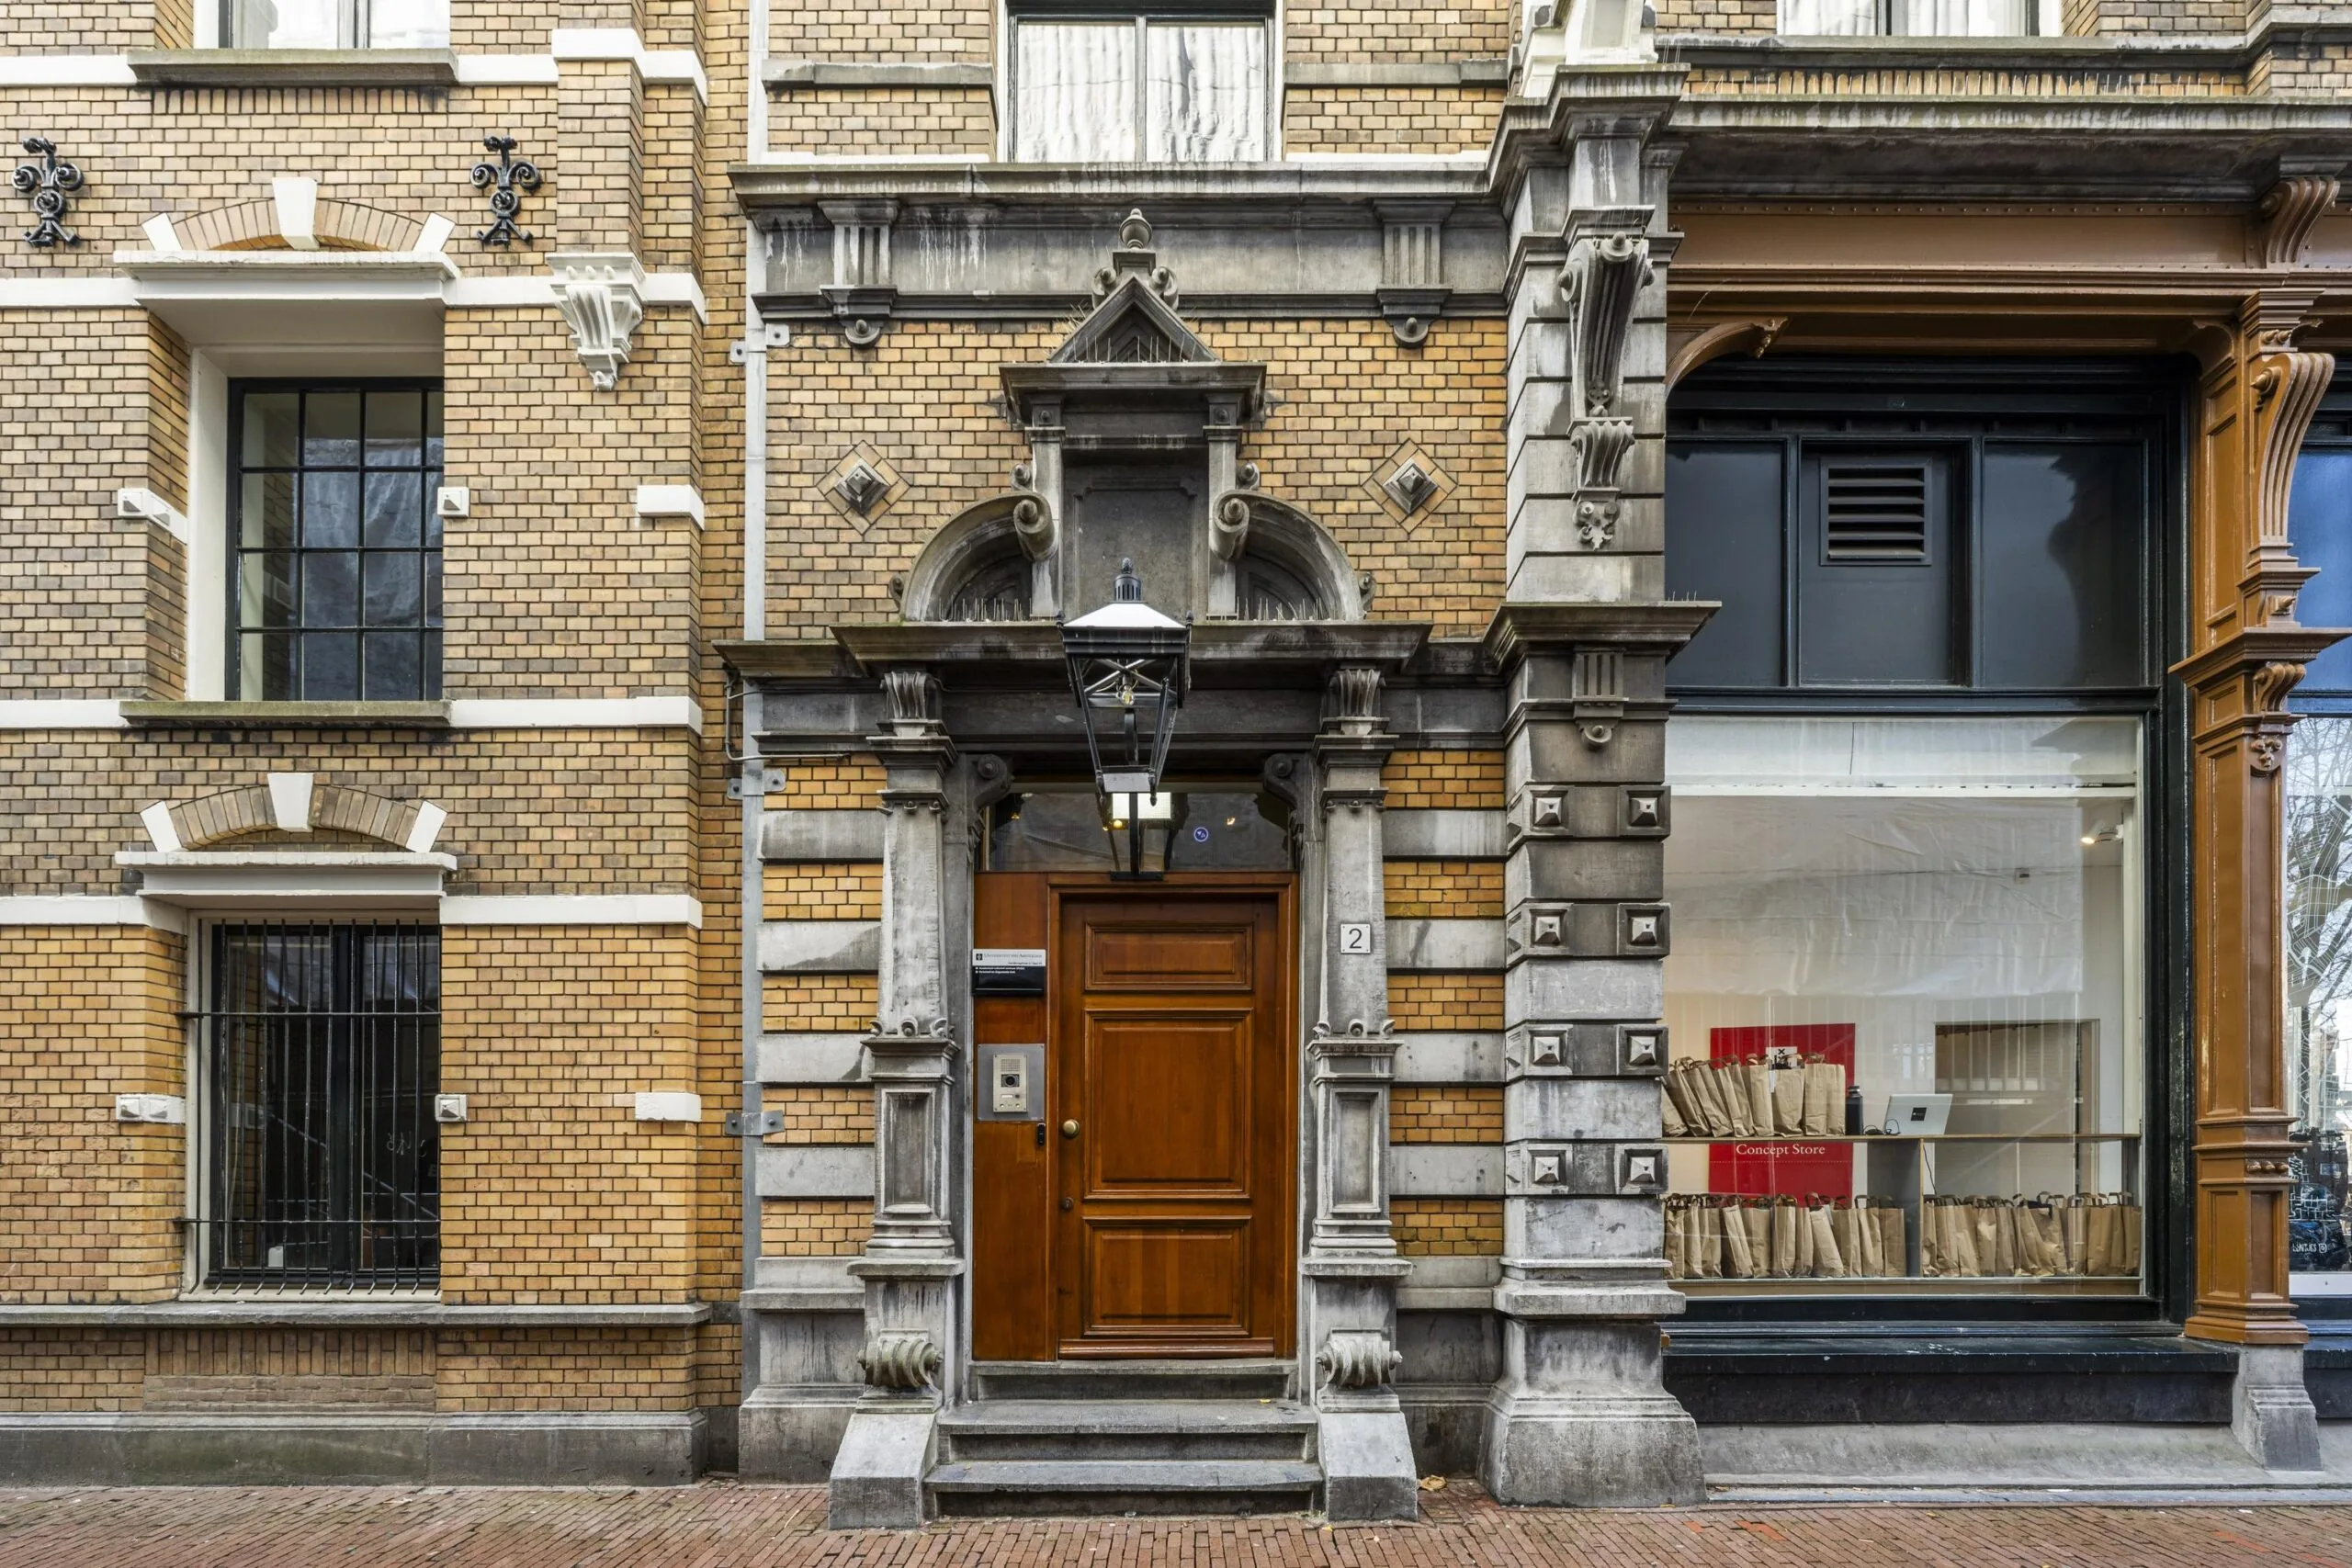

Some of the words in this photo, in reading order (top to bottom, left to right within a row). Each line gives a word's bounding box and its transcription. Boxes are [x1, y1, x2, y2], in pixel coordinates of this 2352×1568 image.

[1349, 928, 1363, 949] 2
[1736, 1144, 1789, 1157] Concept
[1792, 1143, 1826, 1155] Store
